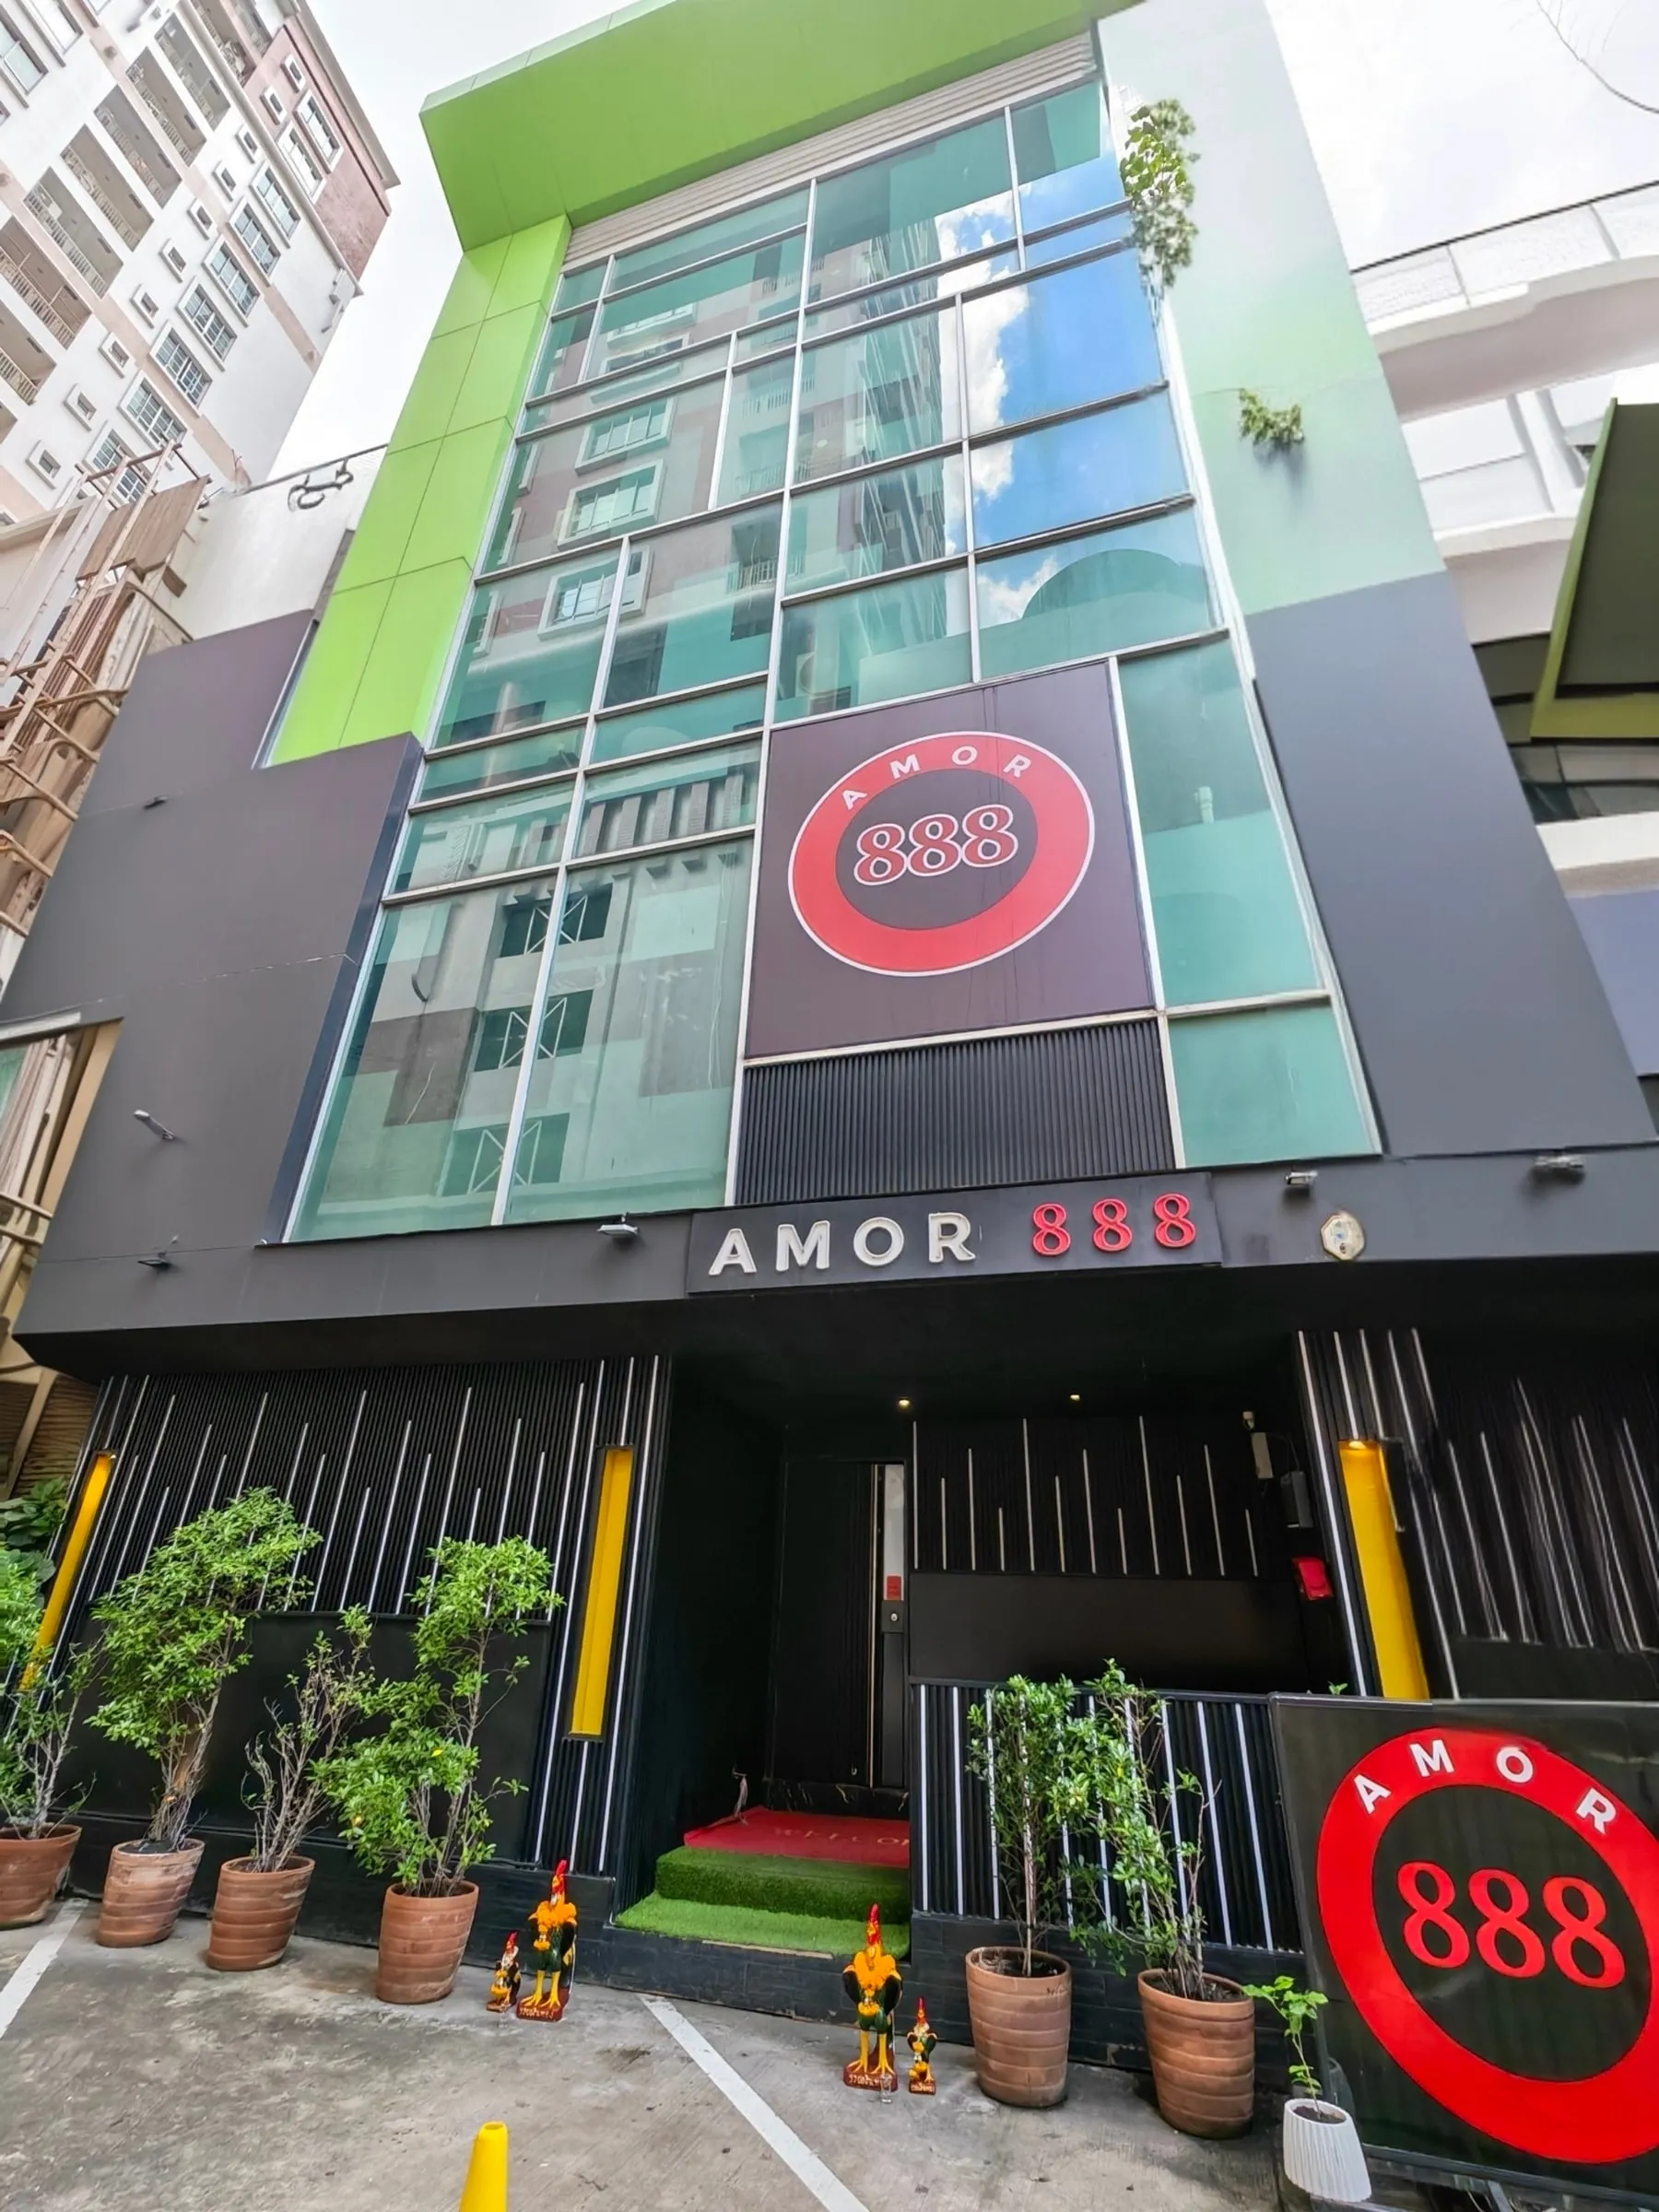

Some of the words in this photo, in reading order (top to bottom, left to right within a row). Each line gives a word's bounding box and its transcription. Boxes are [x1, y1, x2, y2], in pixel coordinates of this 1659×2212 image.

[841, 745, 1031, 810] AMOR
[853, 804, 1018, 886] 888
[708, 1211, 975, 1276] AMOR
[1032, 1193, 1195, 1257] 888
[1353, 1739, 1617, 1835] AMOR
[1396, 1861, 1626, 1989] 888
